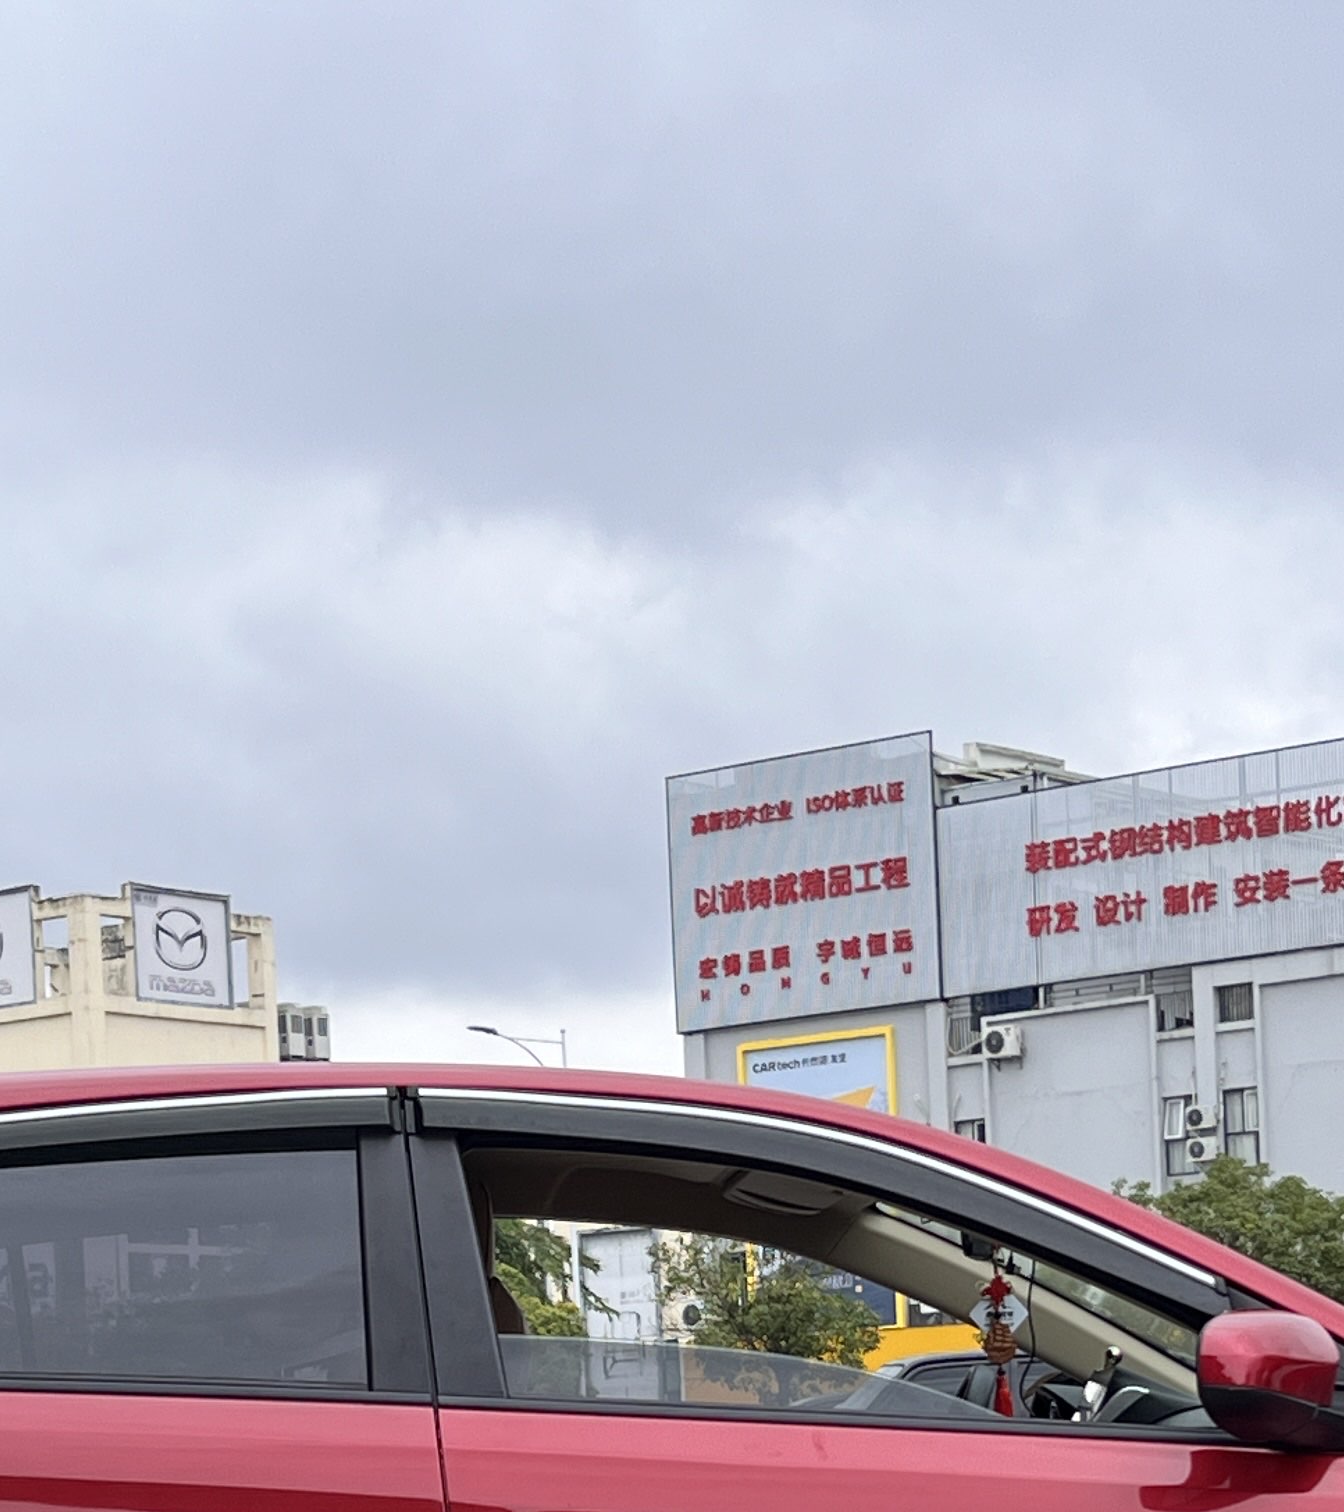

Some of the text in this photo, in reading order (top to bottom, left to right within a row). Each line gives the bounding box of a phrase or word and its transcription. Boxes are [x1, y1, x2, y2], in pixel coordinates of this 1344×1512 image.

[691, 781, 905, 836] 高新技术企业 ISO体系认证
[693, 856, 911, 919] 以诚铸就精品工程
[1026, 902, 1081, 938] 研发
[1093, 891, 1148, 927] 设计
[1162, 880, 1218, 917] 制作
[148, 974, 216, 998] mazda
